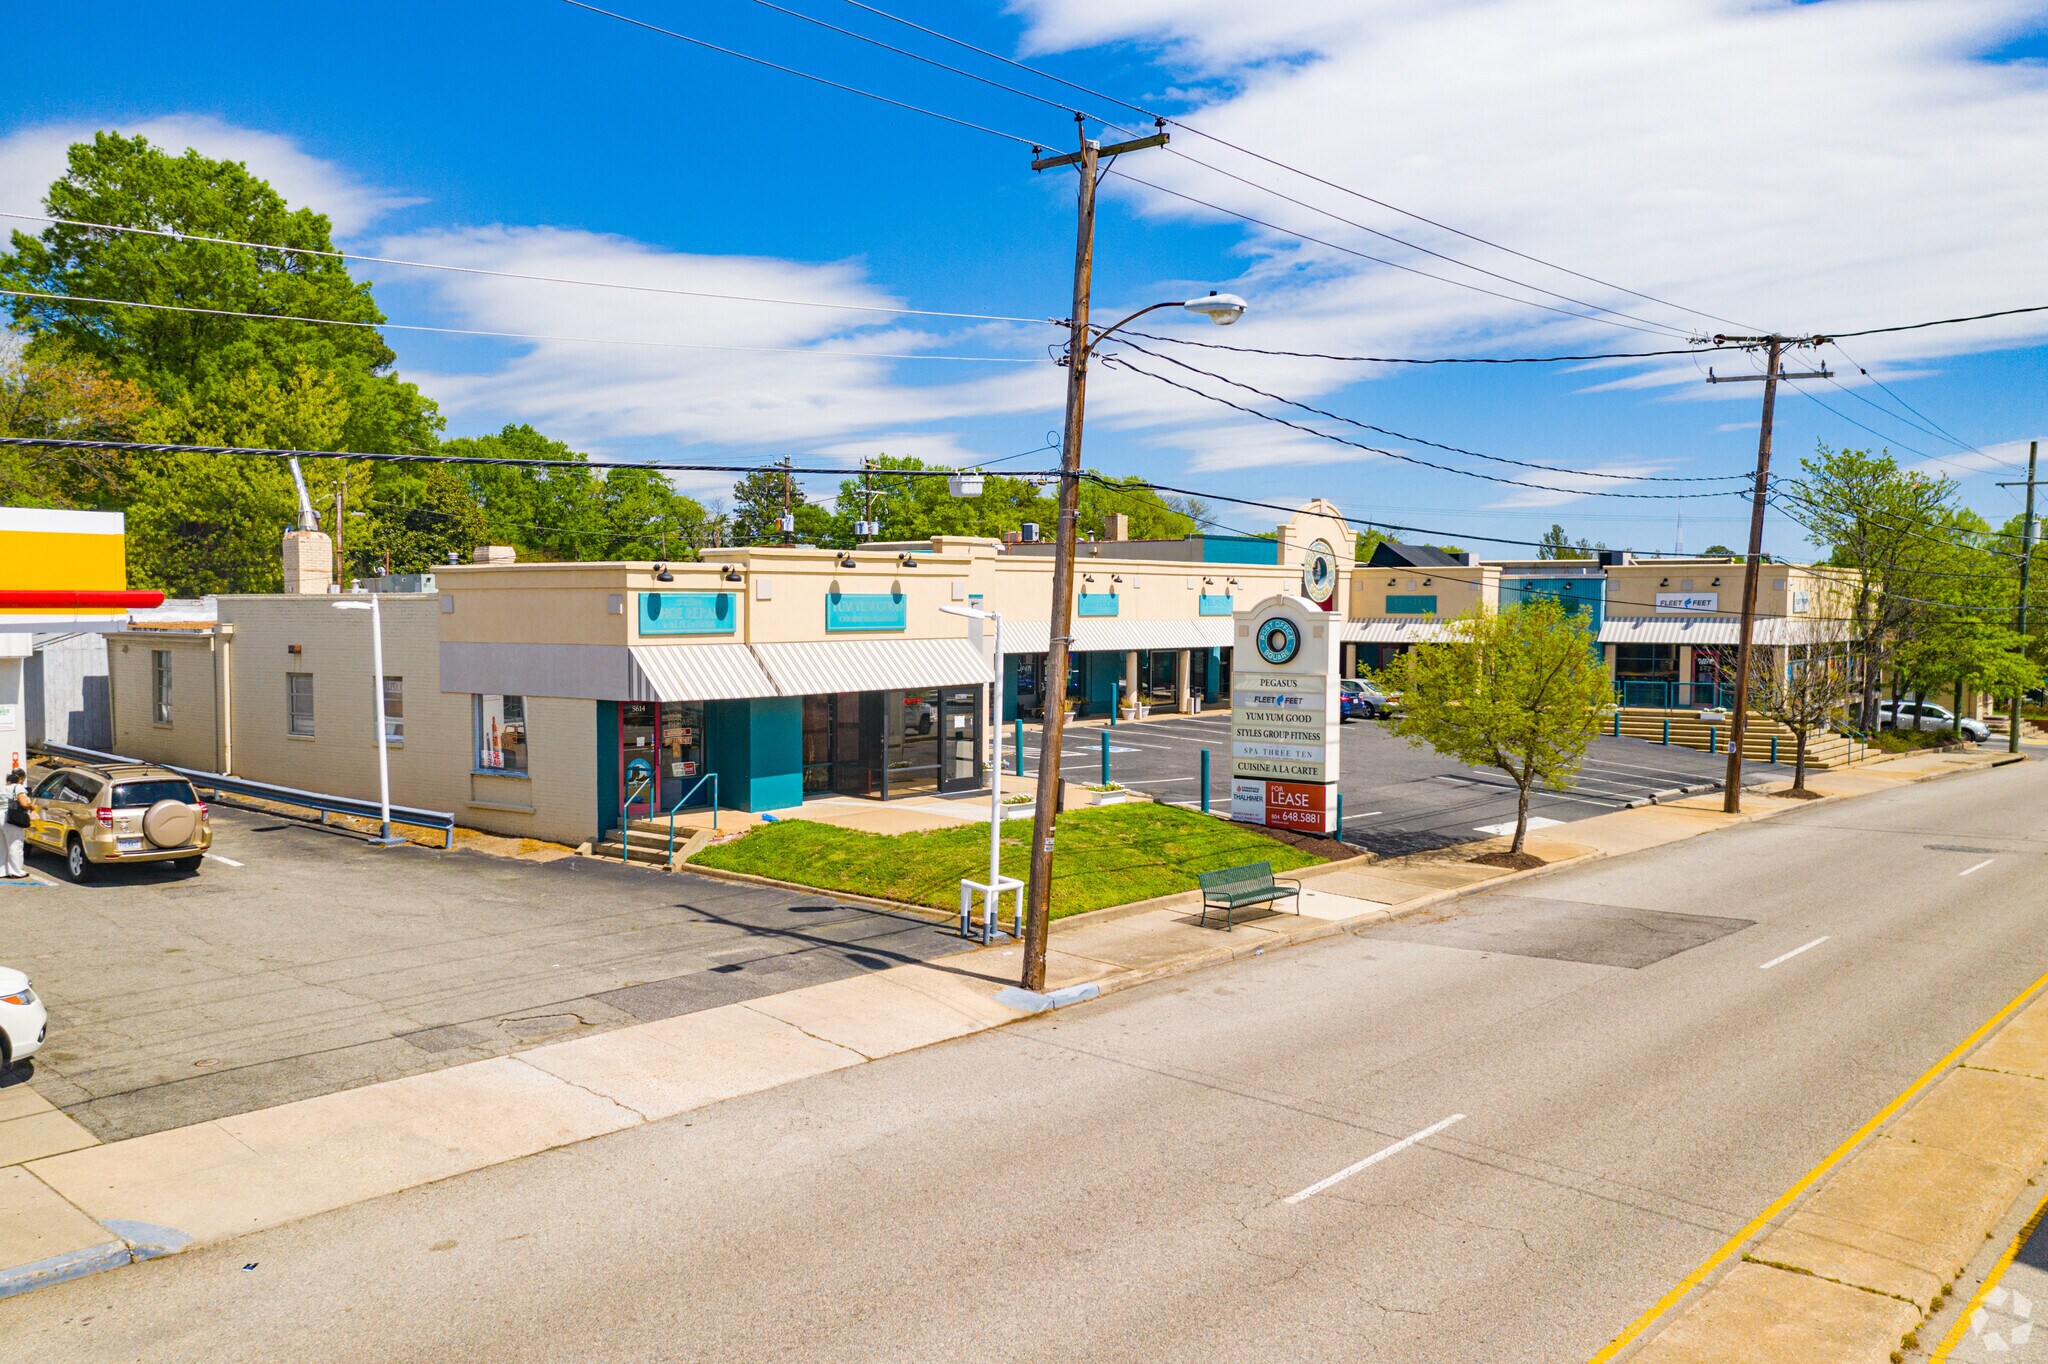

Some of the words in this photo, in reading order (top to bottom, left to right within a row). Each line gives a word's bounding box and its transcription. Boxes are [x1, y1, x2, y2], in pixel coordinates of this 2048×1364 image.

[654, 607, 684, 619] SHOE
[686, 607, 724, 619] REPAIR
[1260, 621, 1273, 640] POST
[1275, 621, 1294, 640] OFFICE
[1264, 650, 1290, 661] SQUARE
[1260, 679, 1298, 687] PEGASUS
[1254, 696, 1276, 704] FLEET
[1246, 712, 1264, 721] YUM
[1266, 713, 1284, 722] YUM
[1286, 714, 1312, 723] GOOD
[1236, 728, 1262, 738] STYLES
[1263, 730, 1289, 739] GROUP
[1291, 731, 1320, 741] FITNESS
[1263, 749, 1291, 757] THREE
[1238, 762, 1271, 772] CUISINE
[1272, 765, 1278, 773] A
[1280, 765, 1289, 773] LA
[1291, 766, 1318, 776] CARTE
[1233, 794, 1264, 803] THALHIMER
[1271, 792, 1309, 807] LEASE
[1282, 811, 1320, 824] 648.5881
